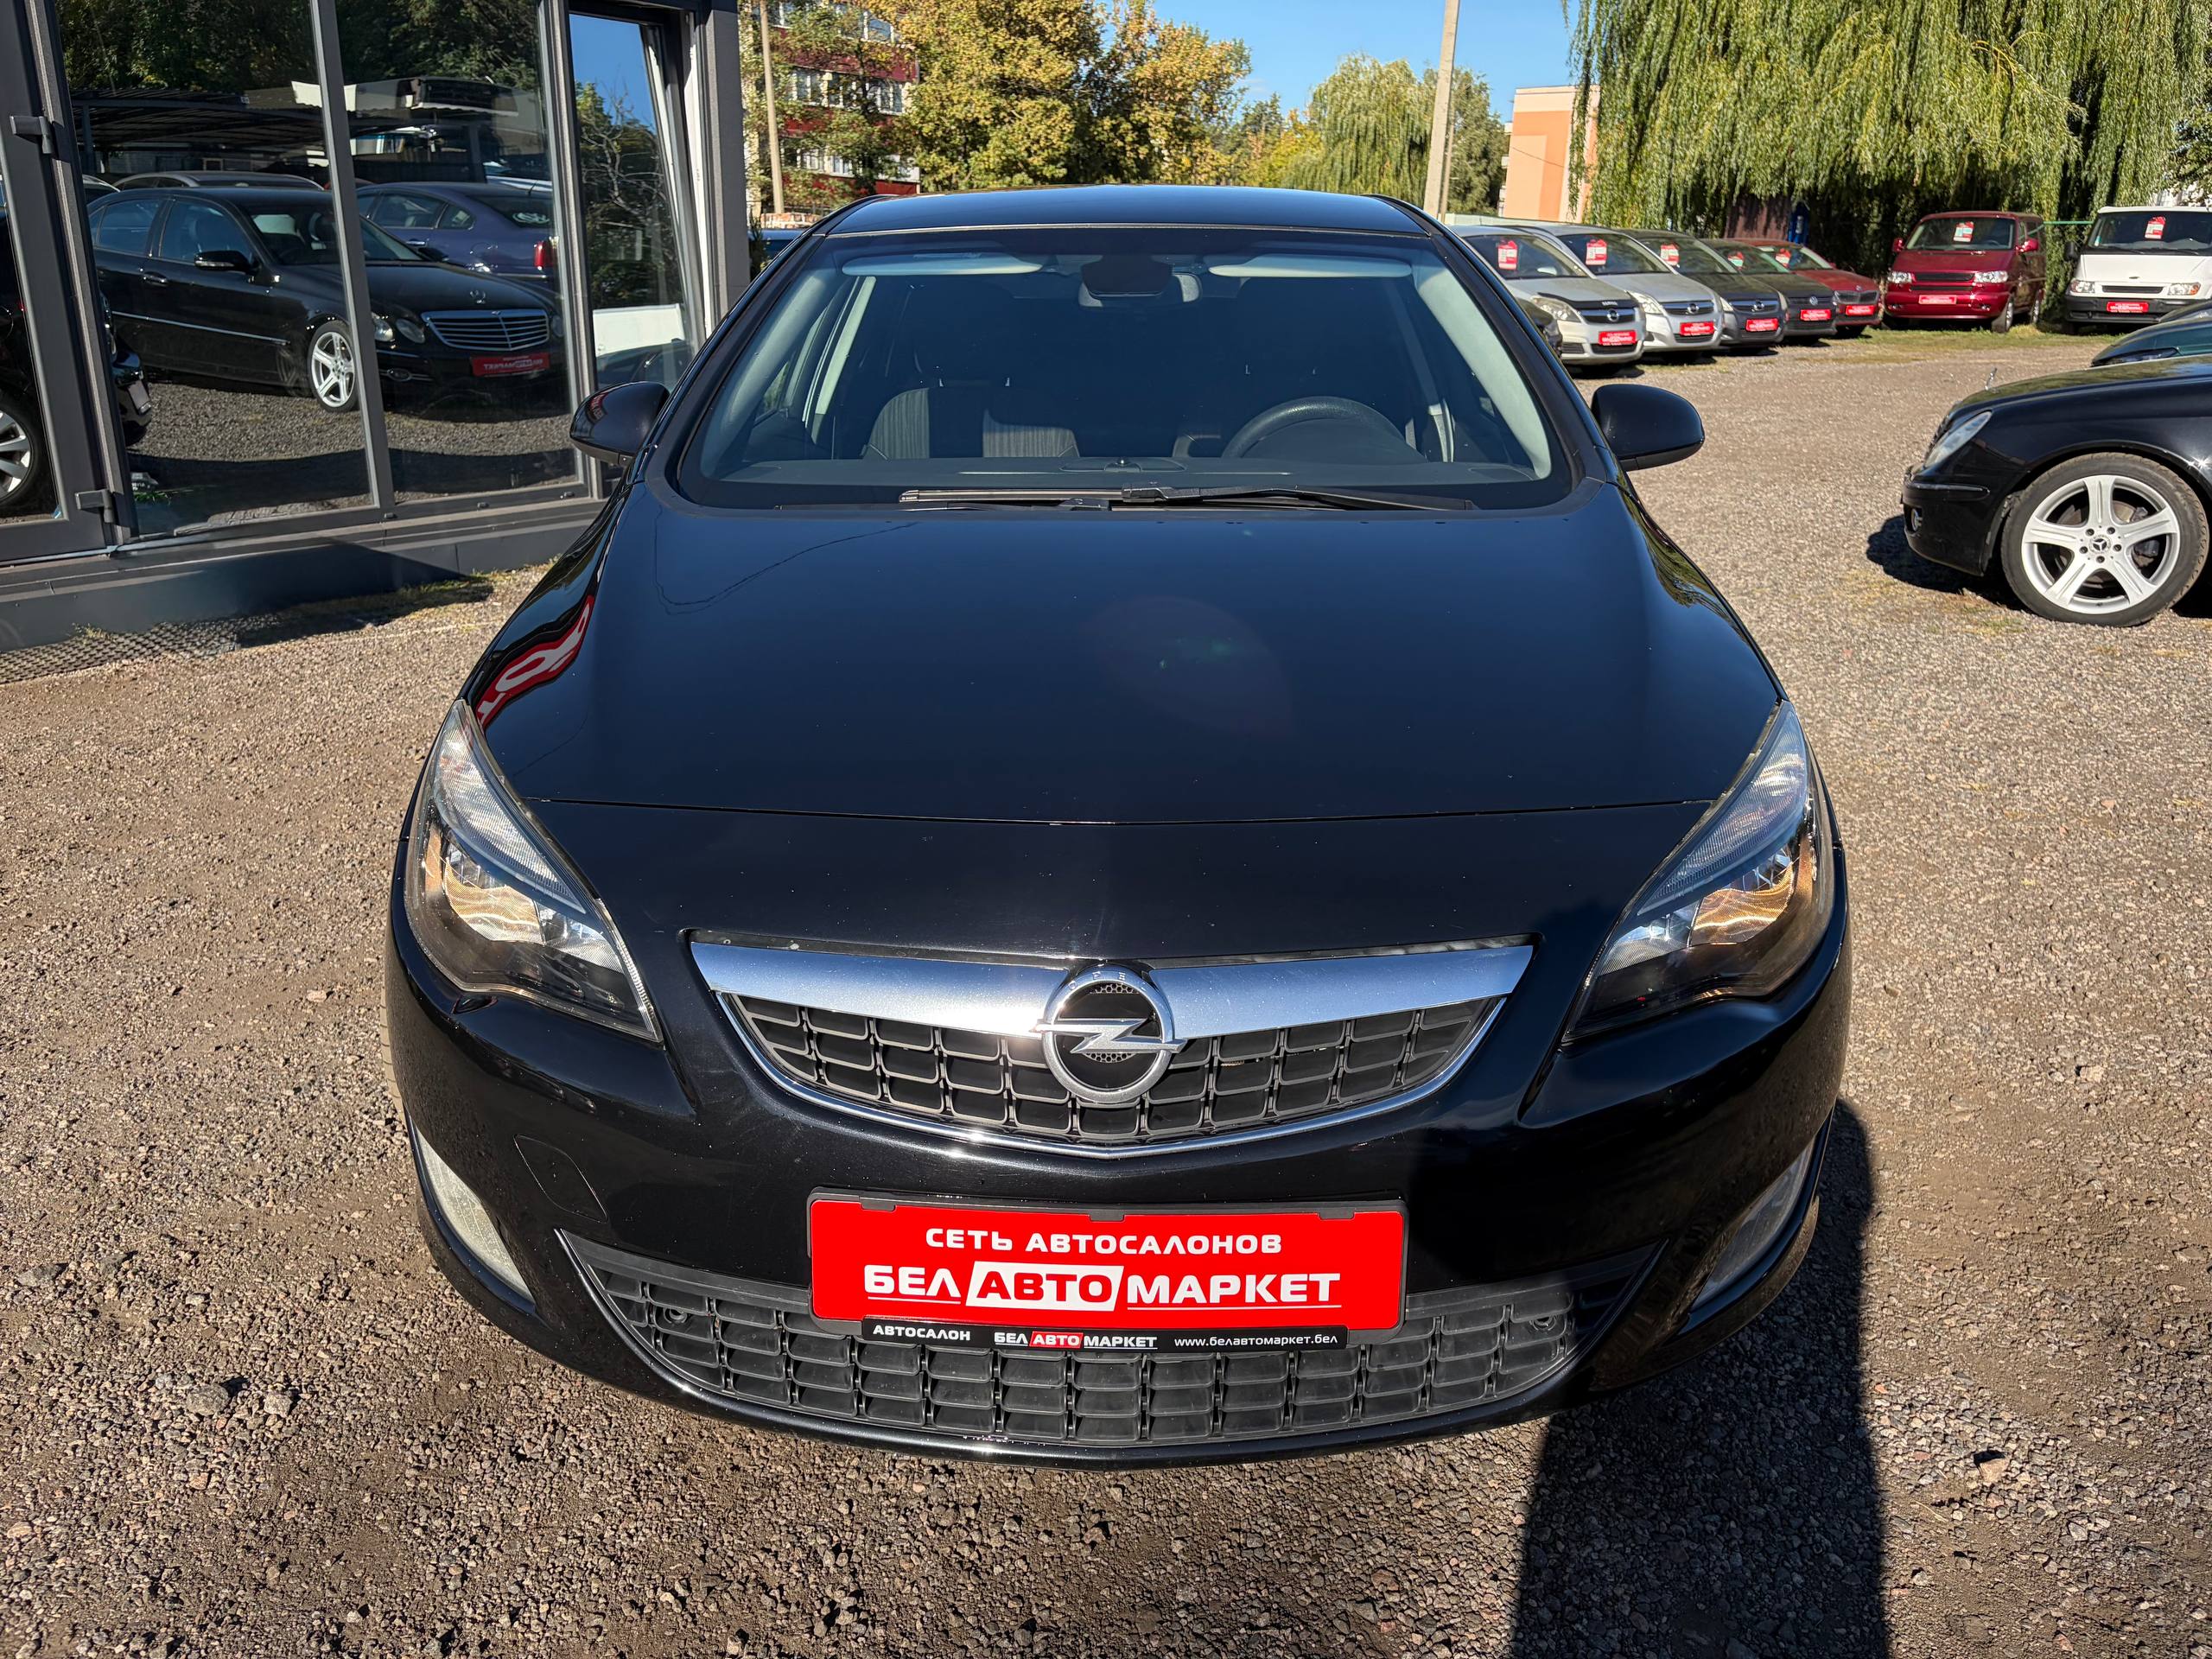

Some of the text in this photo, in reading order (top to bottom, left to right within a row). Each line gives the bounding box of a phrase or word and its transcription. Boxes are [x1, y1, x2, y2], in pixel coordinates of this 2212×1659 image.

[925, 1228, 1282, 1255] СЕТЬ АВТОСАЛОНОВ
[873, 1325, 970, 1341] АВТОСАЛОН
[1173, 1333, 1338, 1348] www.белавтомаркет.бел
